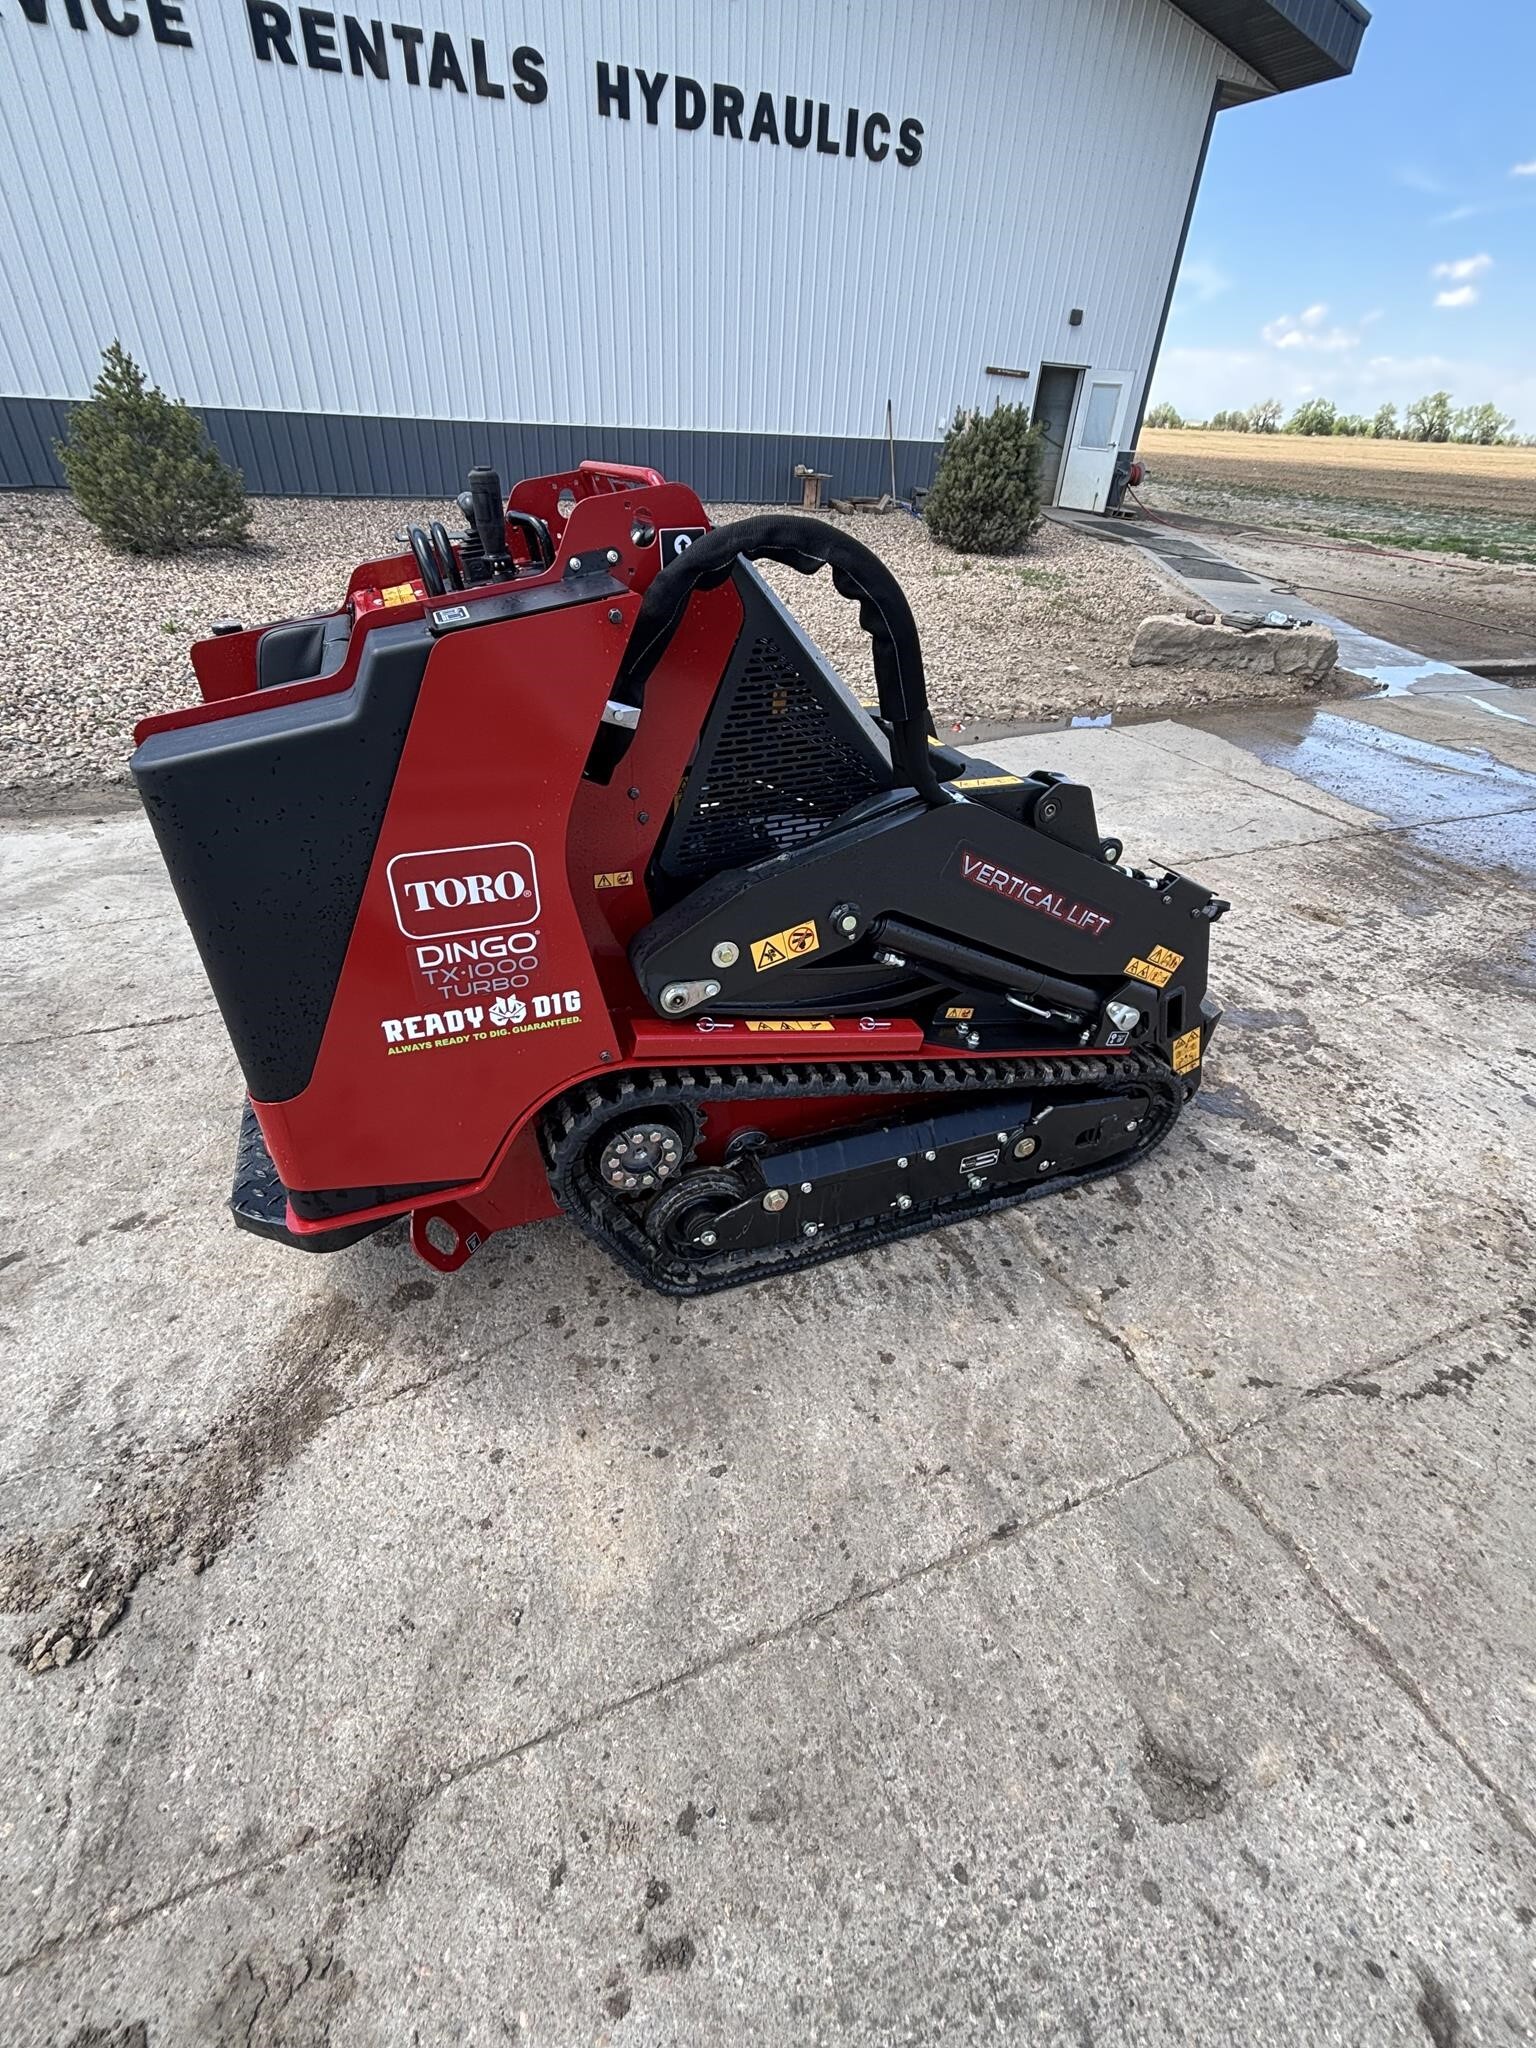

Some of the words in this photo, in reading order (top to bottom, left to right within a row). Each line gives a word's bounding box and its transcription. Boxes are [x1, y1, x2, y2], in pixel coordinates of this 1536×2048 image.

[246, 0, 549, 104] RENTALS
[596, 61, 925, 167] HYDRAULICS
[962, 854, 1062, 917] VERTICAL
[1066, 904, 1110, 935] LIFT
[416, 932, 537, 968] DINGO
[438, 974, 529, 999] TURBO
[381, 1005, 484, 1043] READY
[531, 990, 581, 1018] DIG
[388, 1041, 433, 1056] ALWAYS
[434, 1035, 470, 1048] READY
[472, 1031, 488, 1041] TO
[489, 1028, 511, 1038] DIG.
[512, 1016, 582, 1034] GUARANTEED.
